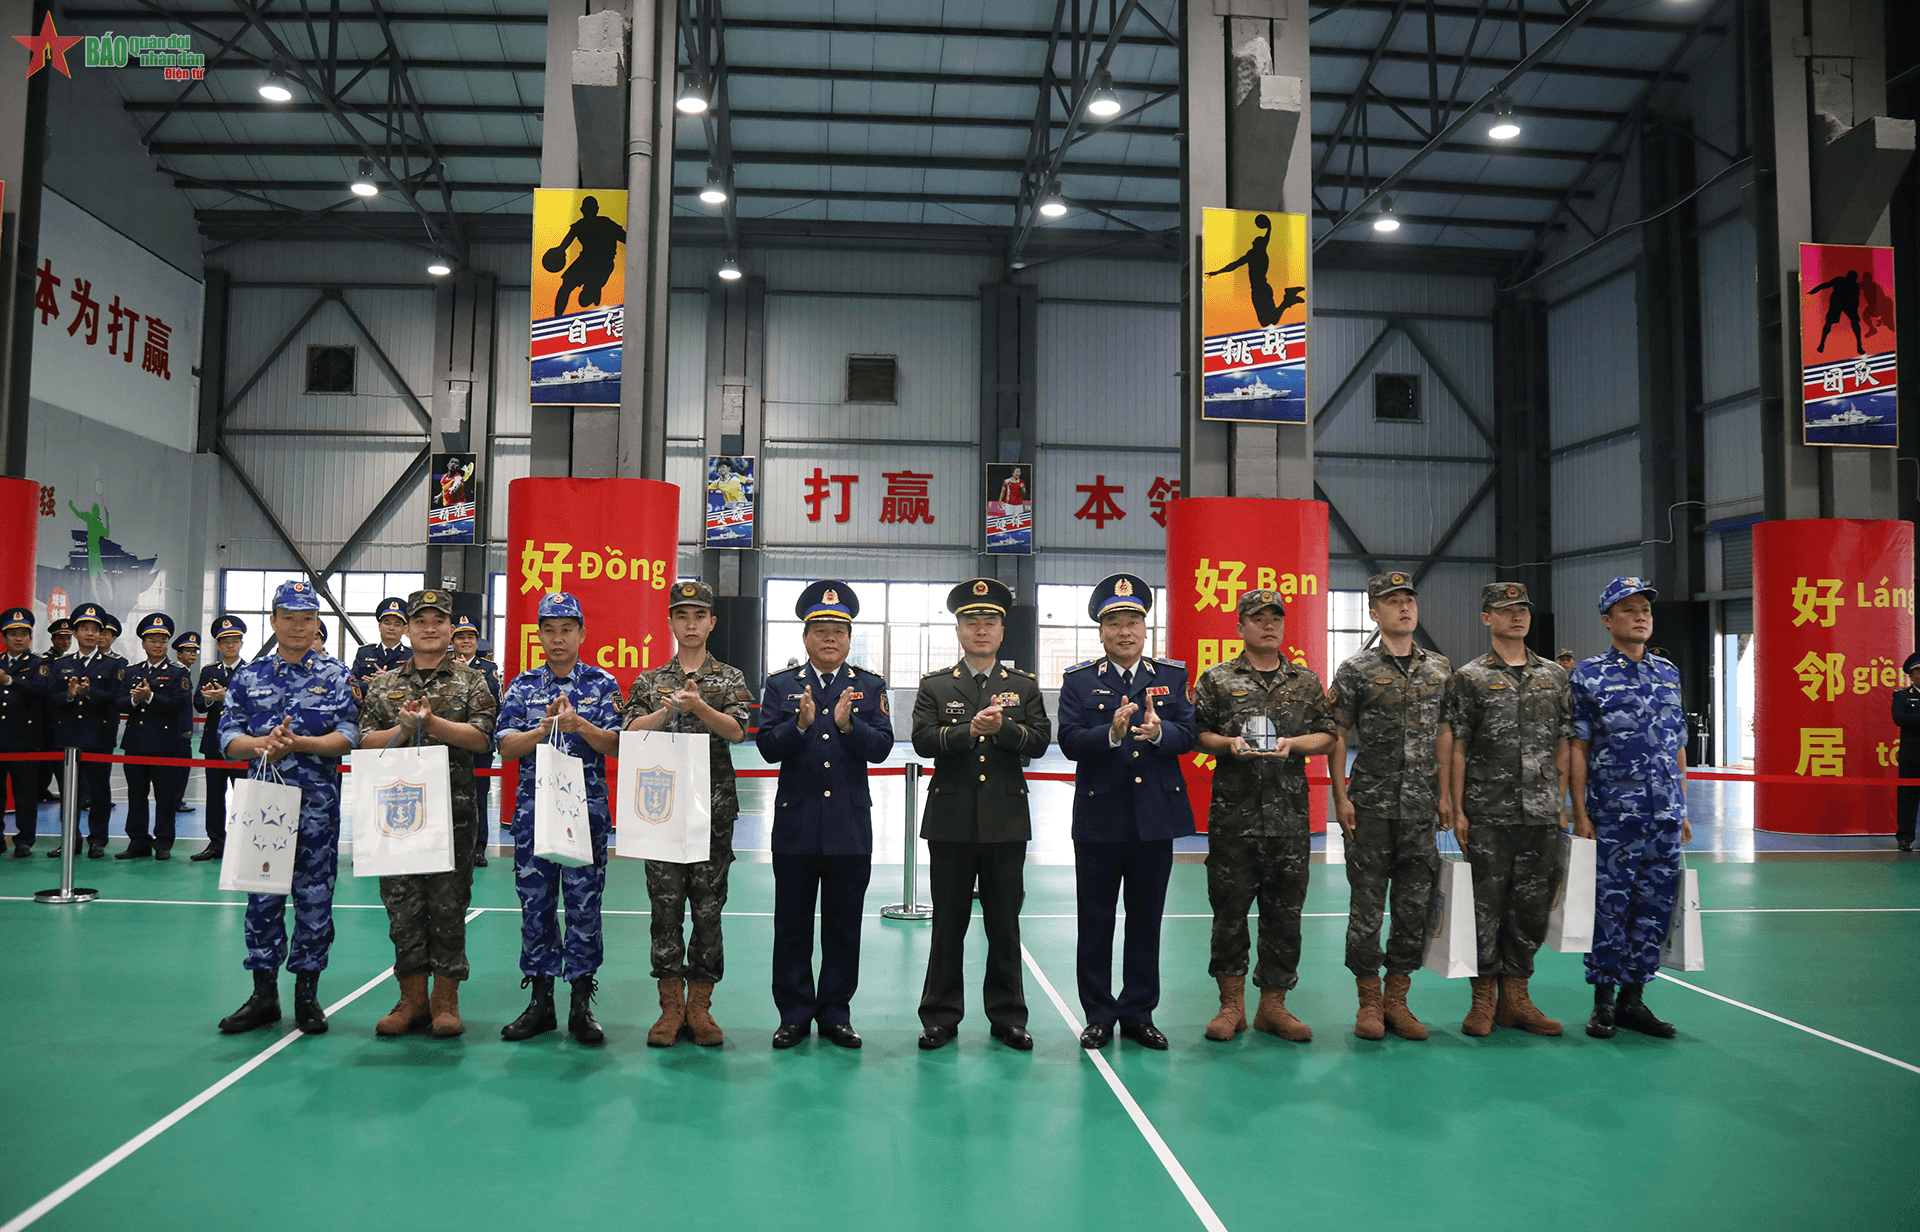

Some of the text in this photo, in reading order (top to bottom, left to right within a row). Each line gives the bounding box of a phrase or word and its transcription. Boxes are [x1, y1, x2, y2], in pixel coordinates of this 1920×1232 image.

[568, 308, 624, 345] 自信
[1221, 330, 1287, 366] 挑战
[1822, 360, 1880, 394] 团队
[803, 467, 935, 525] 打赢
[578, 545, 666, 590] Đồng
[1257, 567, 1318, 603] Bạn
[597, 633, 653, 669] chí
[1792, 577, 1846, 777] 好邻居
